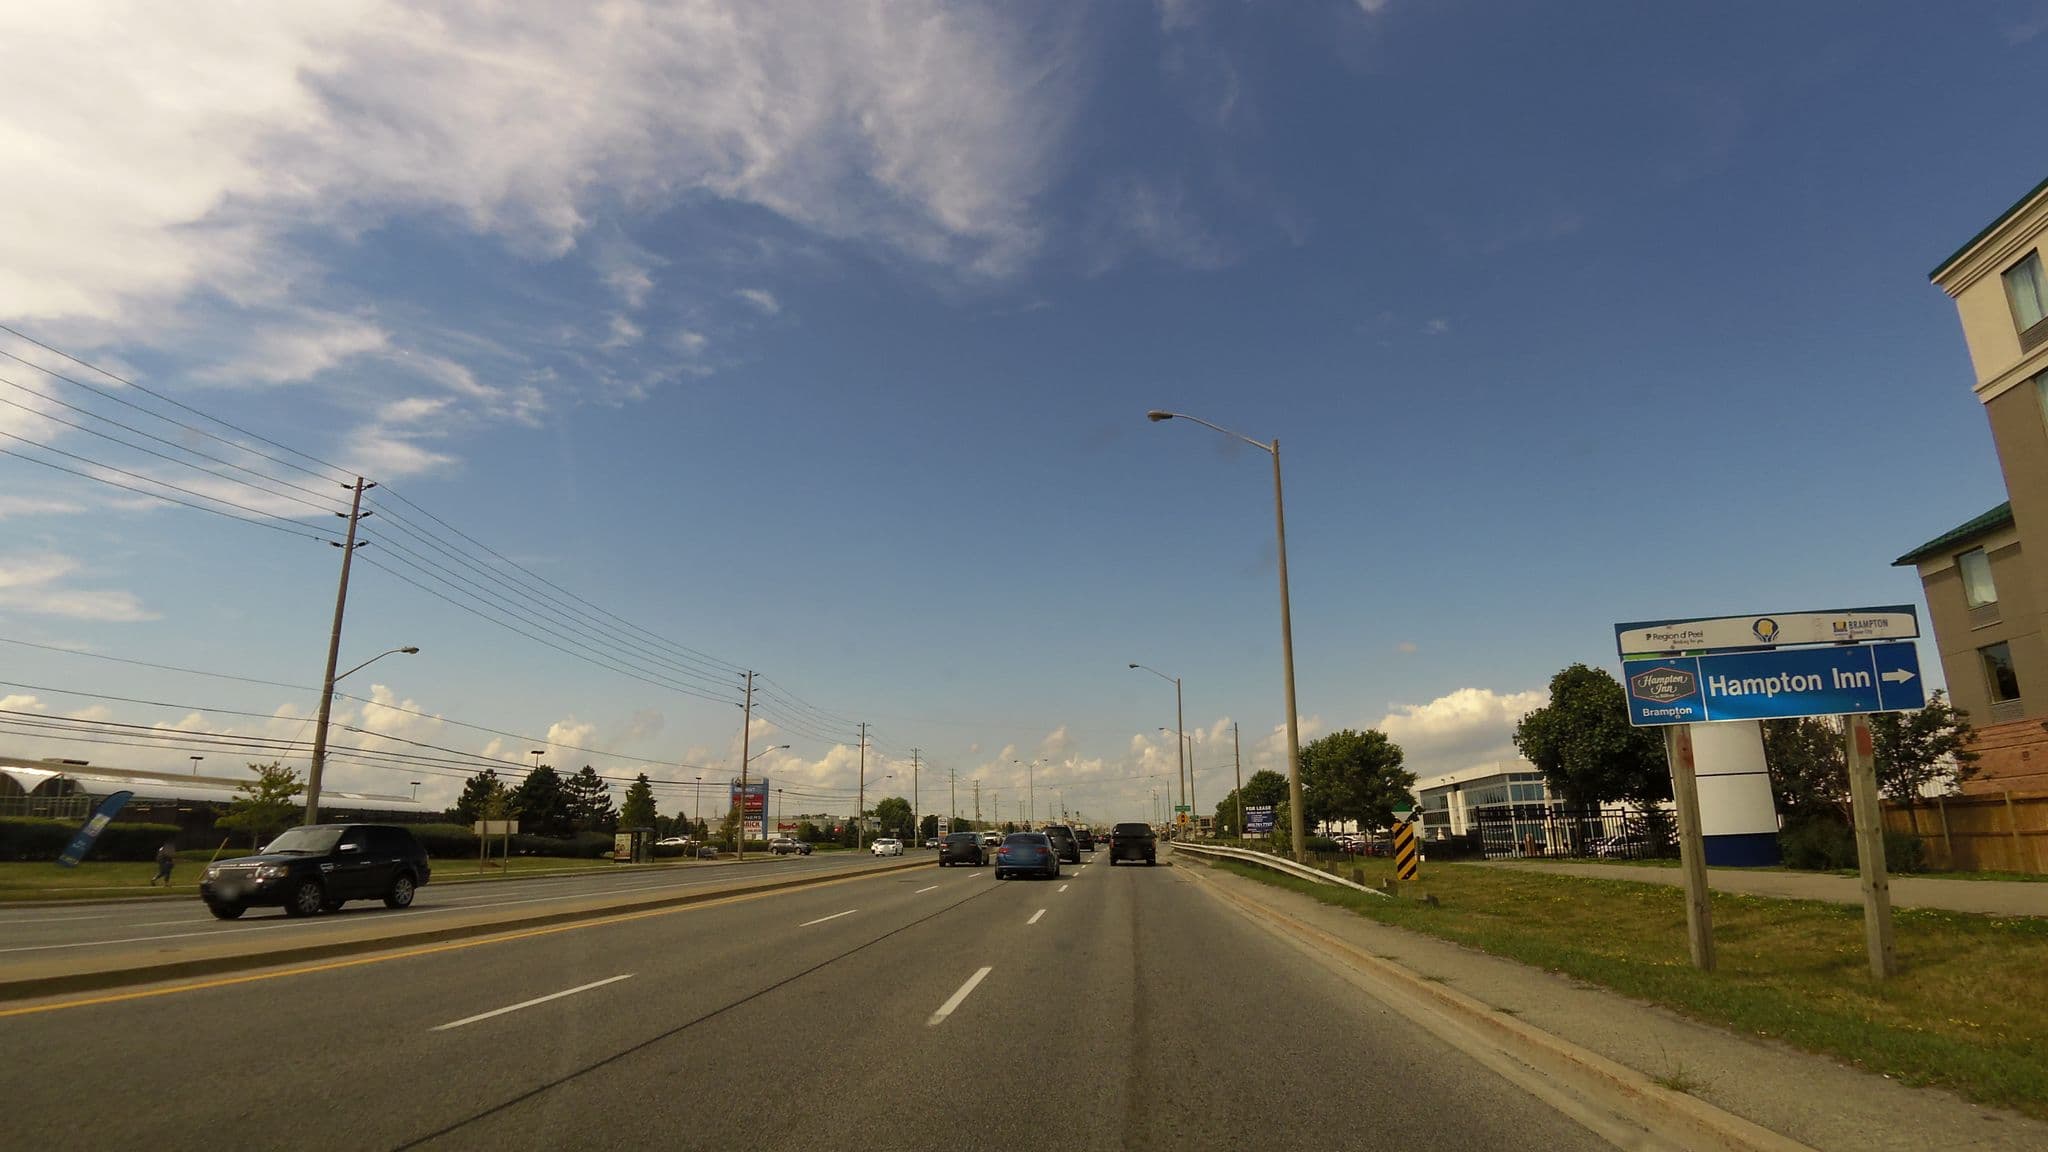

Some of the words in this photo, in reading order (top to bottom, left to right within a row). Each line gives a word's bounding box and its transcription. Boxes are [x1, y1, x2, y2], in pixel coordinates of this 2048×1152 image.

[1848, 619, 1888, 629] BRAMPTON
[1652, 633, 1680, 641] Region
[1688, 630, 1704, 638] Peel
[1638, 674, 1687, 687] Hampton
[1707, 671, 1822, 698] Hampton
[1831, 667, 1871, 689] Inn
[1650, 684, 1677, 694] Inn
[1642, 707, 1693, 718] Brampton
